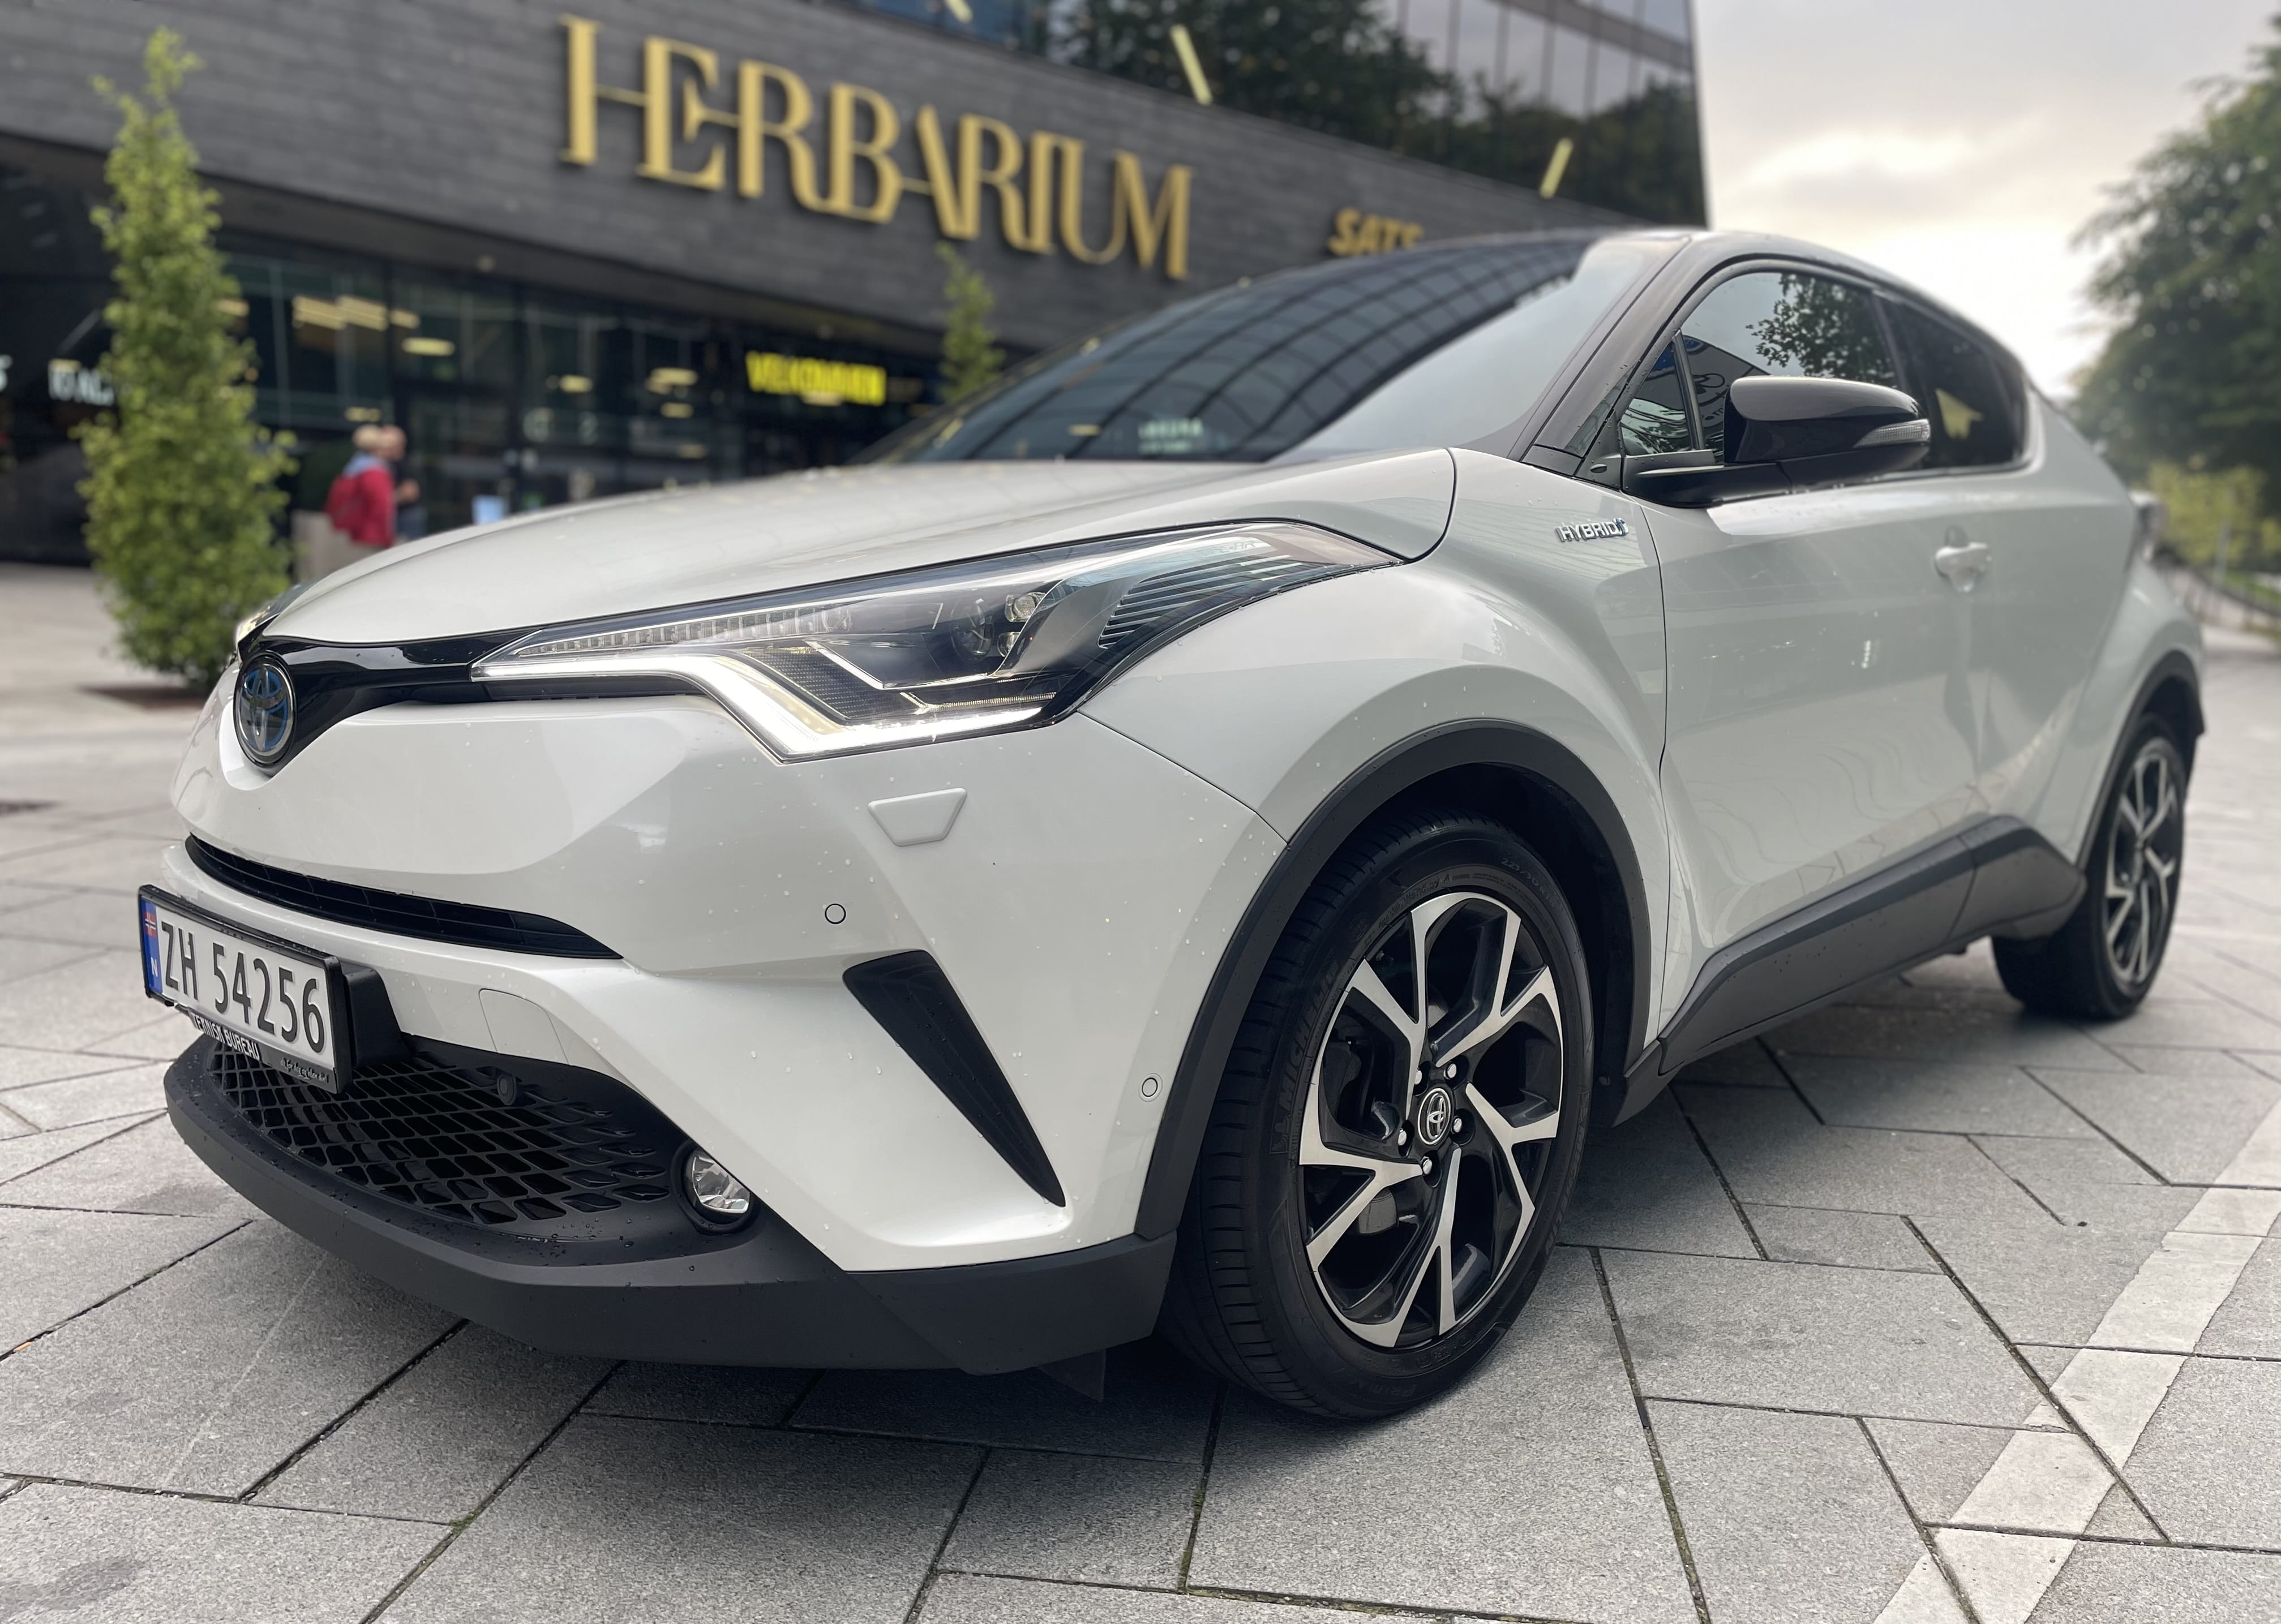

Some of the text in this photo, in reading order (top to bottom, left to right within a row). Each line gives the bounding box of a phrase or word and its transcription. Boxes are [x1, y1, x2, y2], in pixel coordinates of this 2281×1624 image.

[559, 15, 1195, 281] HERBARIUM
[1554, 521, 1619, 543] HYBRID
[151, 957, 158, 977] N
[161, 921, 325, 1053] ZH 54256
[224, 1029, 260, 1060] BUREAU
[1278, 960, 1340, 1112] MICHELIN
